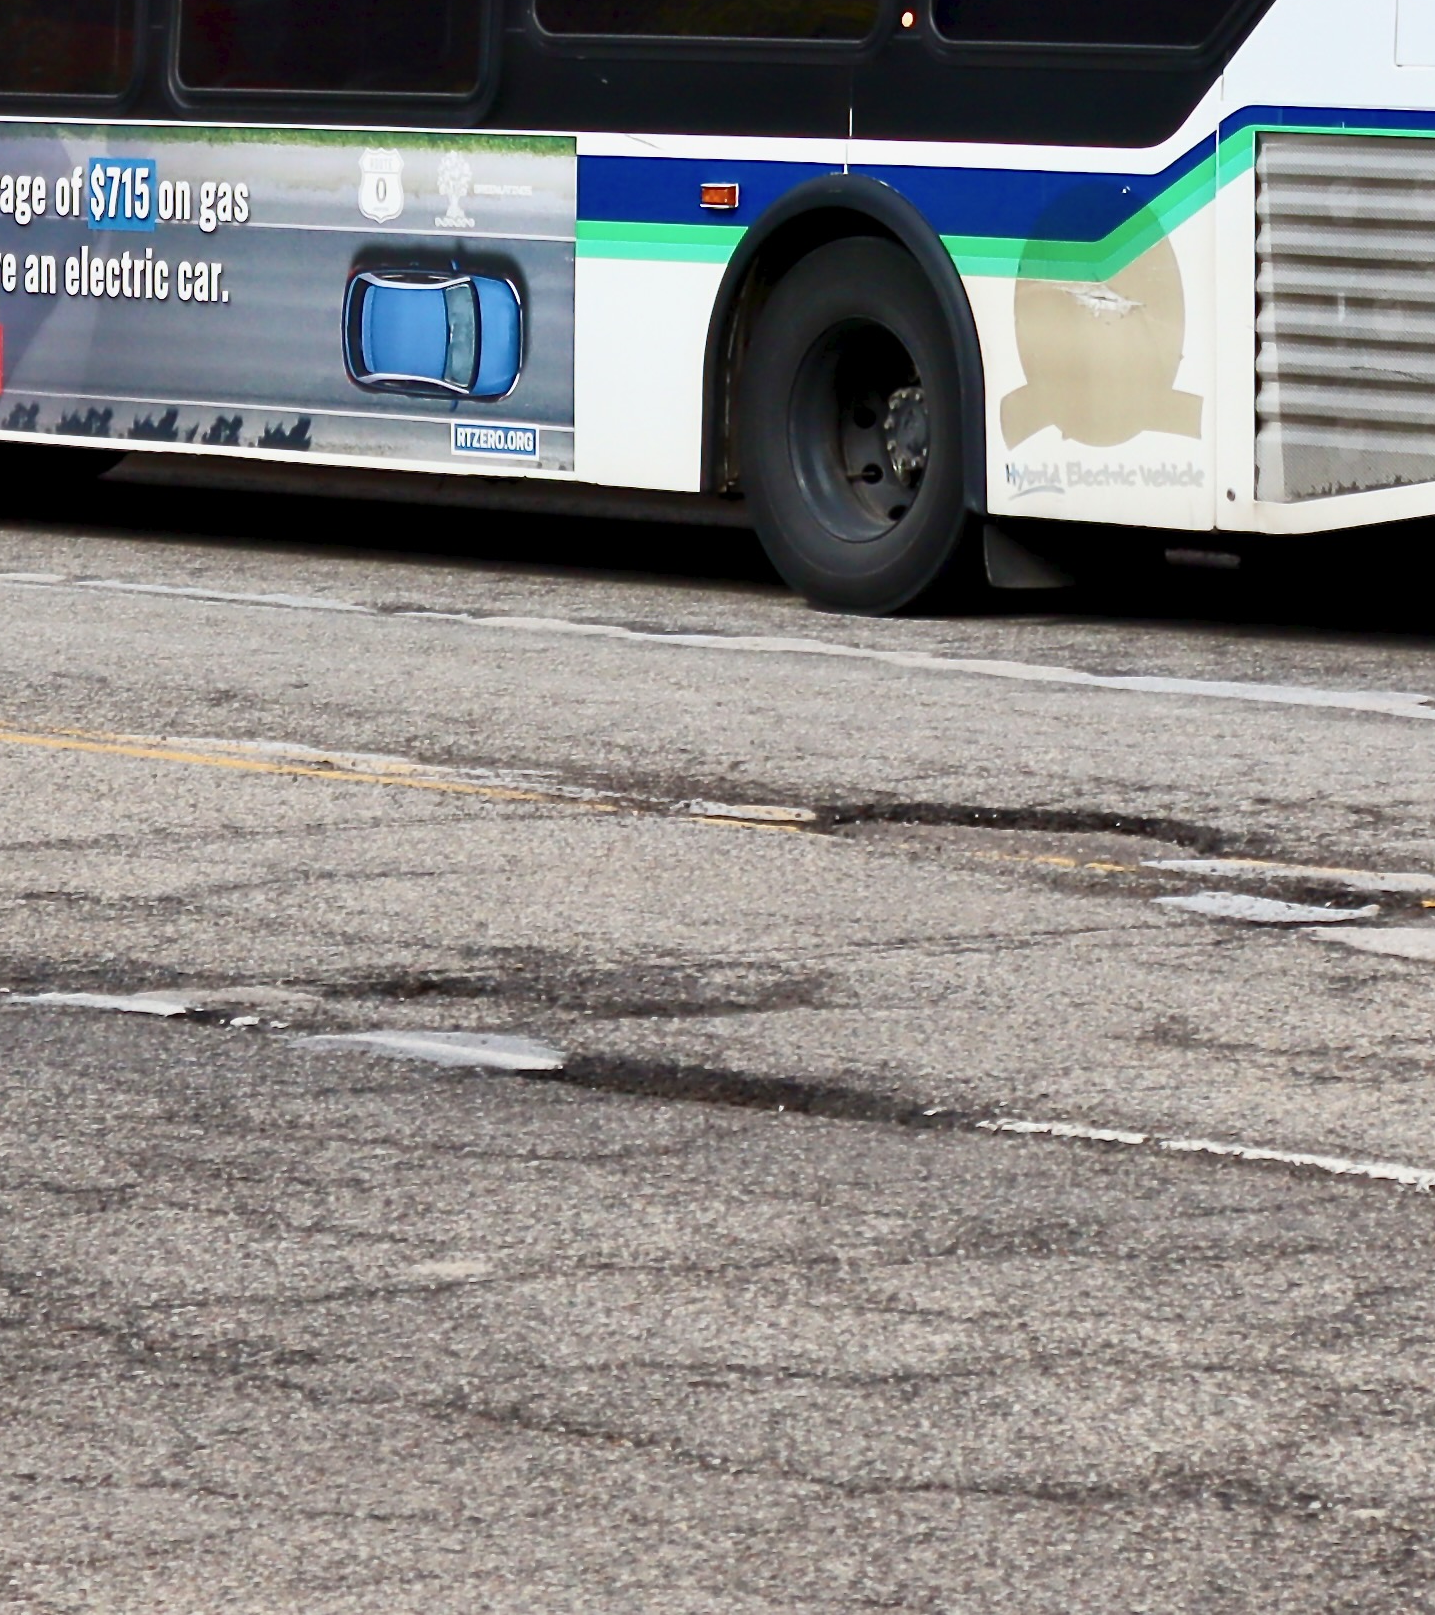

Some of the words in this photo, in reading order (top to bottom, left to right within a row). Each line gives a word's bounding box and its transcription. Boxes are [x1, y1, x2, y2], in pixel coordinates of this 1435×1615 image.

[55, 166, 83, 217] of
[90, 163, 150, 221] $715
[158, 180, 191, 220] on
[199, 181, 249, 233] gas
[24, 253, 57, 295] an
[65, 245, 169, 300] electric
[177, 260, 230, 303] car.
[456, 427, 535, 453] RTZERO.ORG
[1005, 462, 1061, 491] Hybrid
[1066, 461, 1136, 488] Electric
